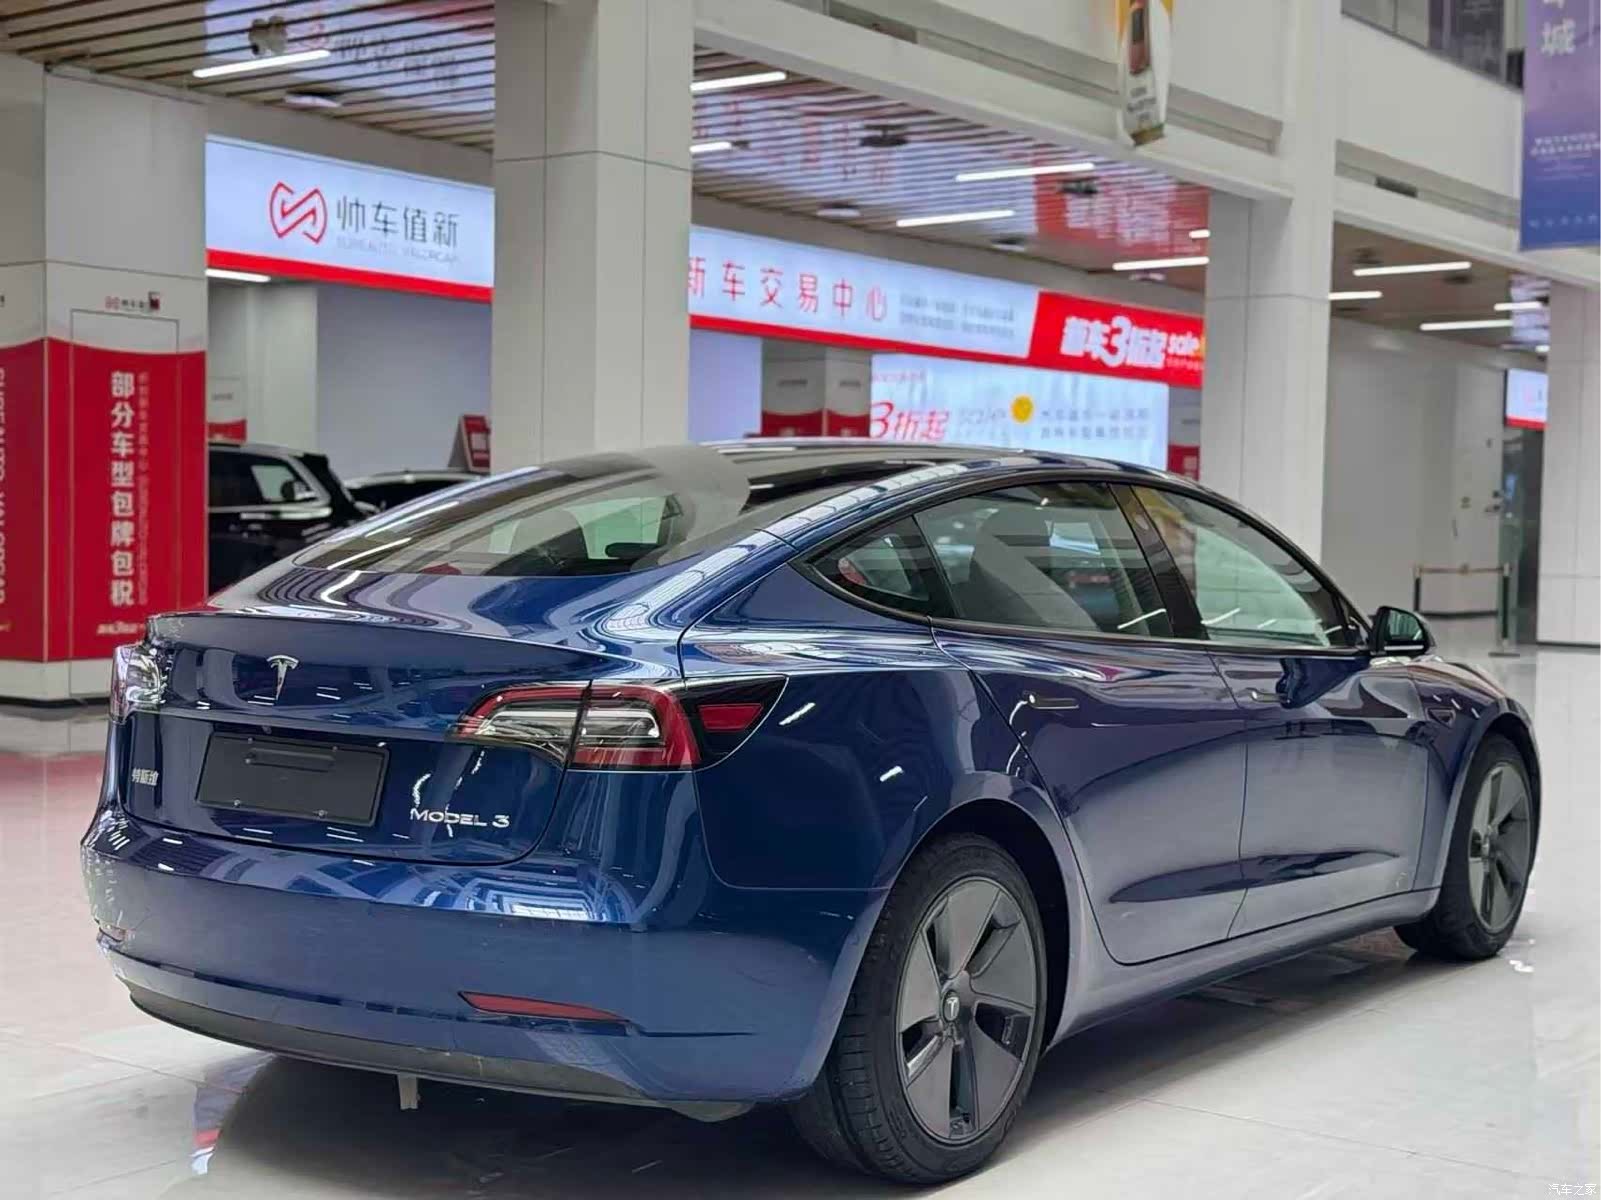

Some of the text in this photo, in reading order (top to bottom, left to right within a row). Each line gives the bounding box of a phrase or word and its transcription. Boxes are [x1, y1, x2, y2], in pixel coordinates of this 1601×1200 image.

[336, 195, 460, 248] 帅车值新
[109, 370, 135, 607] 部分车型包牌包税
[410, 807, 510, 828] MODEL 3
